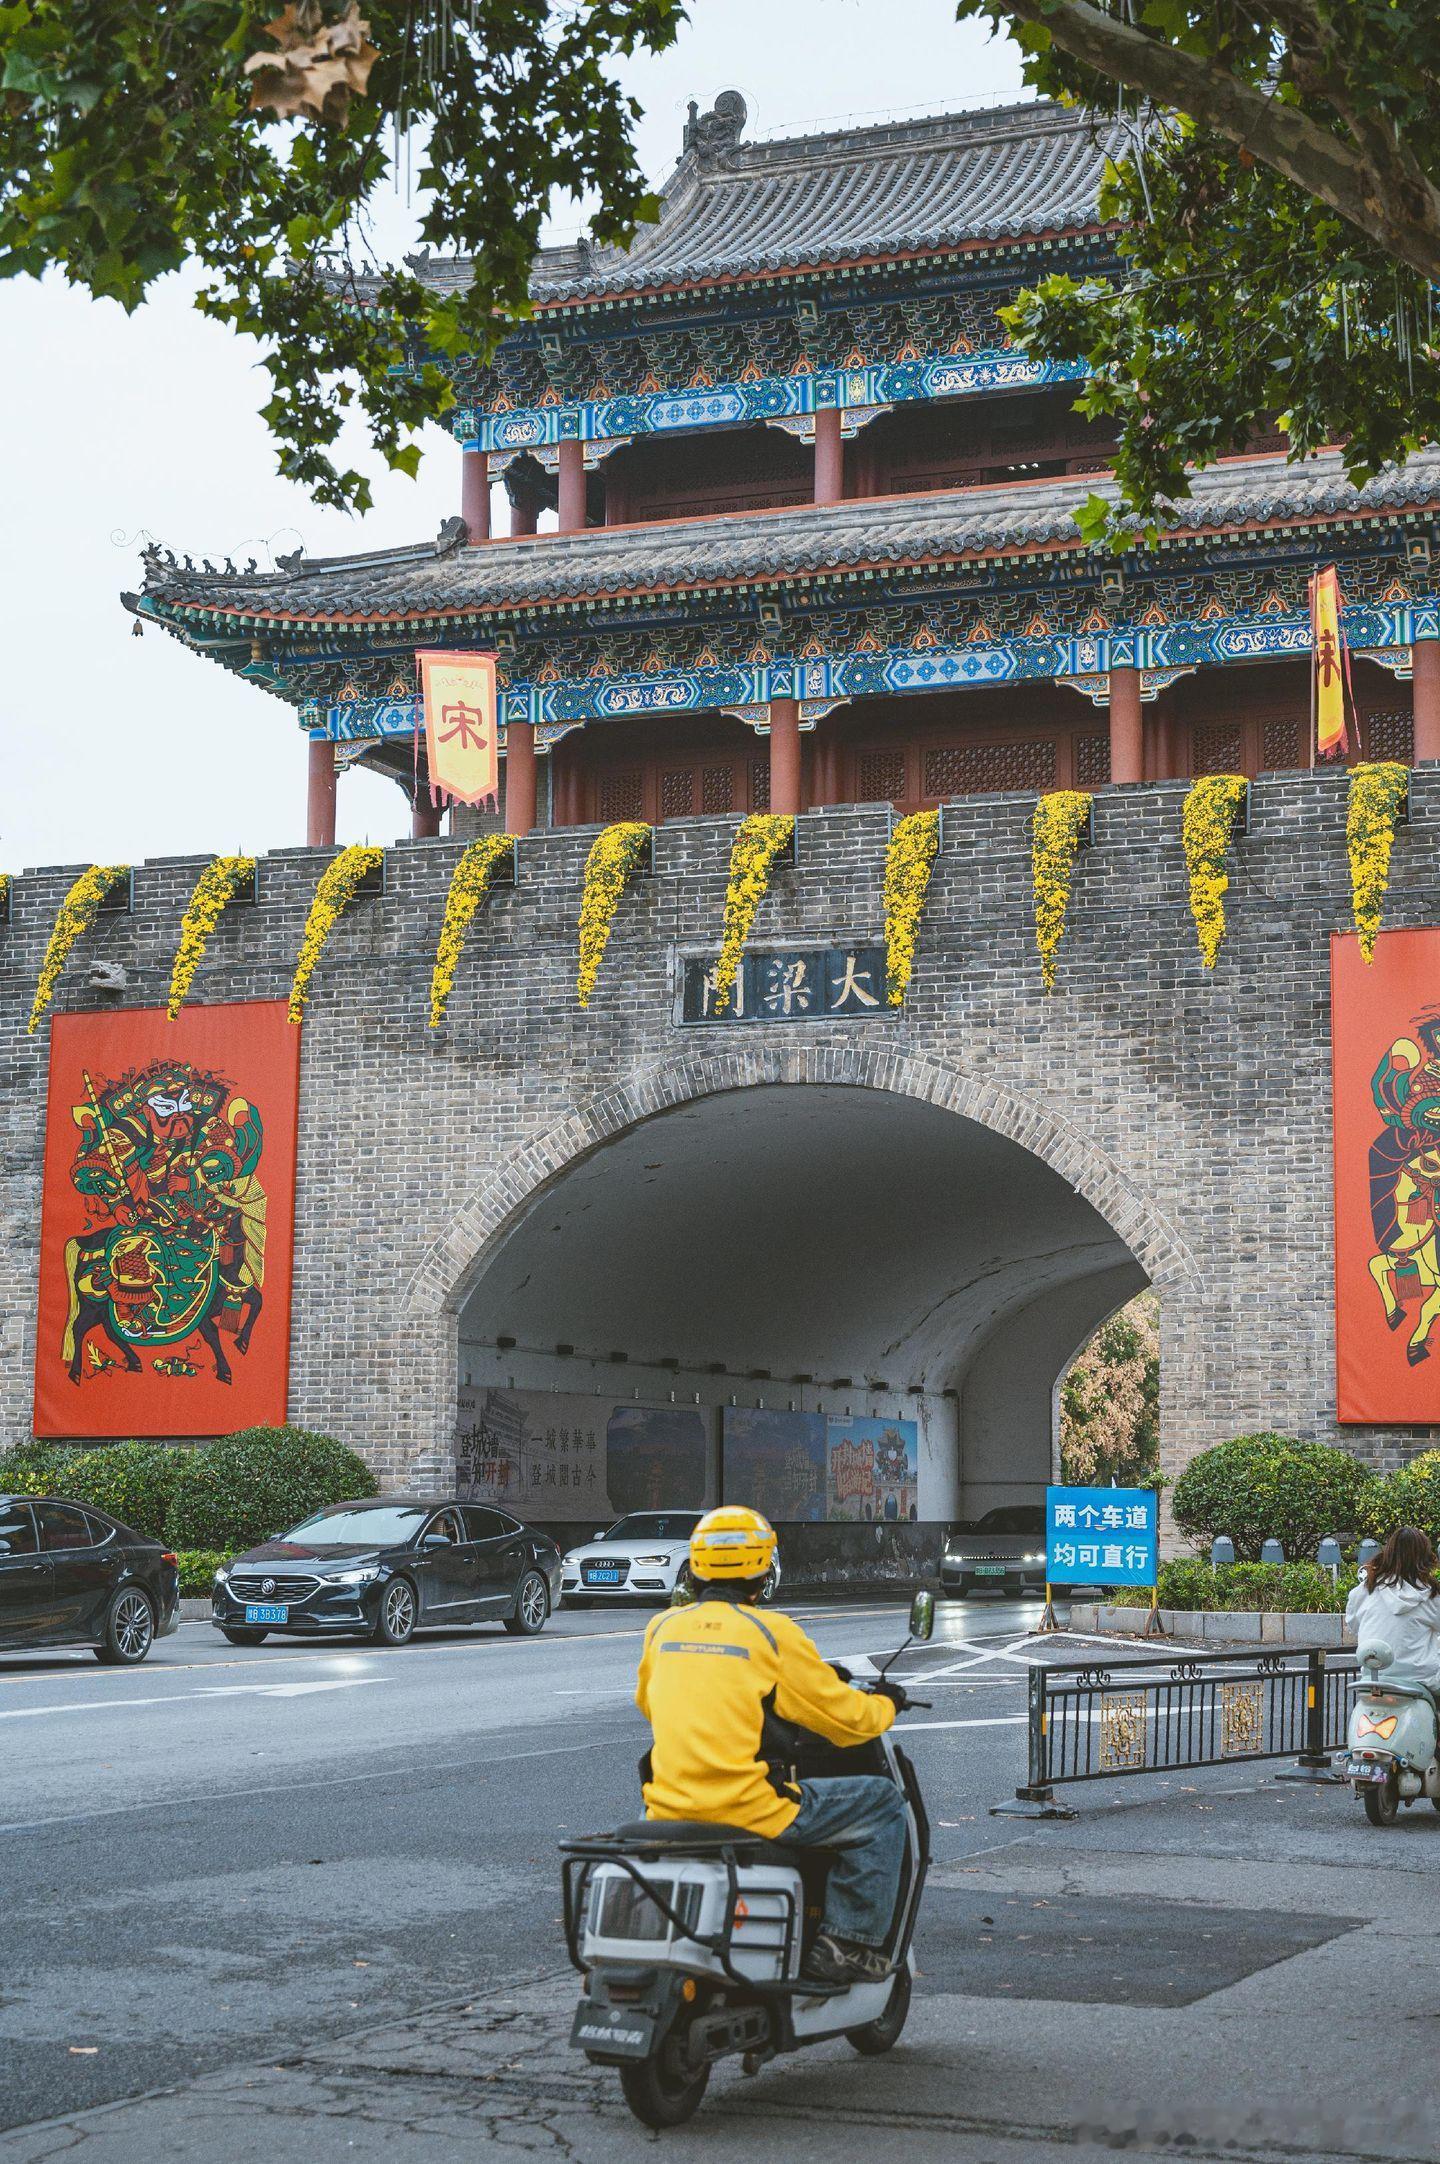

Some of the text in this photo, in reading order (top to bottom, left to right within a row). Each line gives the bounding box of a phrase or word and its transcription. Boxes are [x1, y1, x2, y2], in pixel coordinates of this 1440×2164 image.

[438, 700, 488, 750] 宋
[1054, 1504, 1148, 1529] 两个车道
[1053, 1543, 1148, 1569] 均可直行
